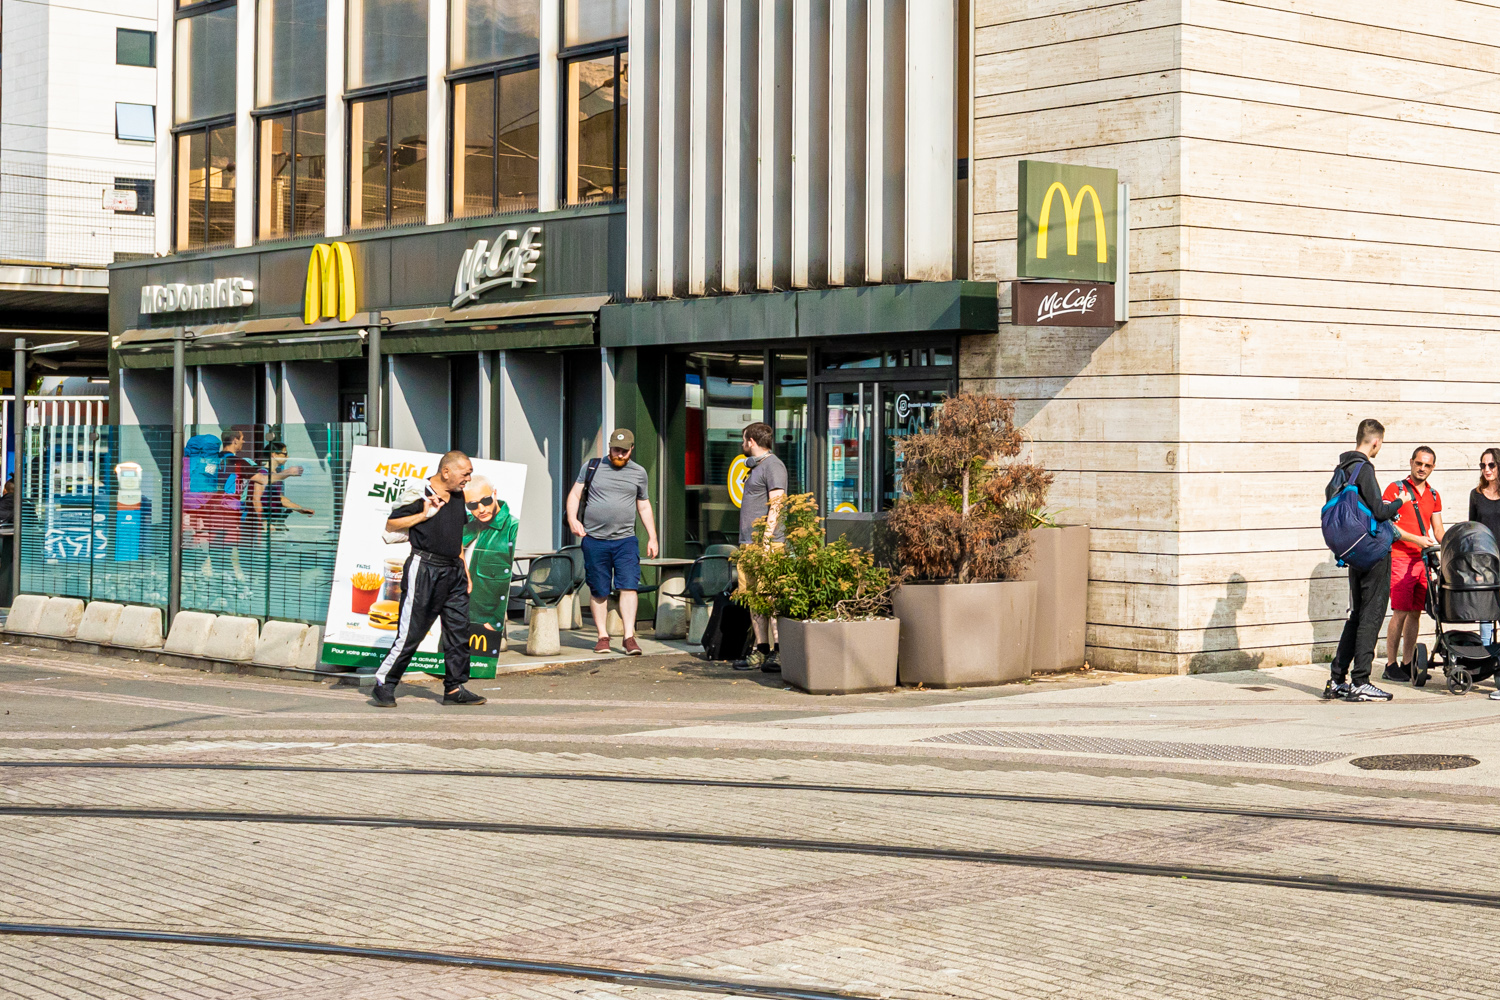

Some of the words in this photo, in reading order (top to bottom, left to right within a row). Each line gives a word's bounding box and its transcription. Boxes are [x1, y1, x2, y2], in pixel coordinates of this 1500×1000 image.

[140, 277, 254, 314] McDonald's
[1037, 287, 1098, 322] McCafé
[375, 462, 428, 479] MENU
